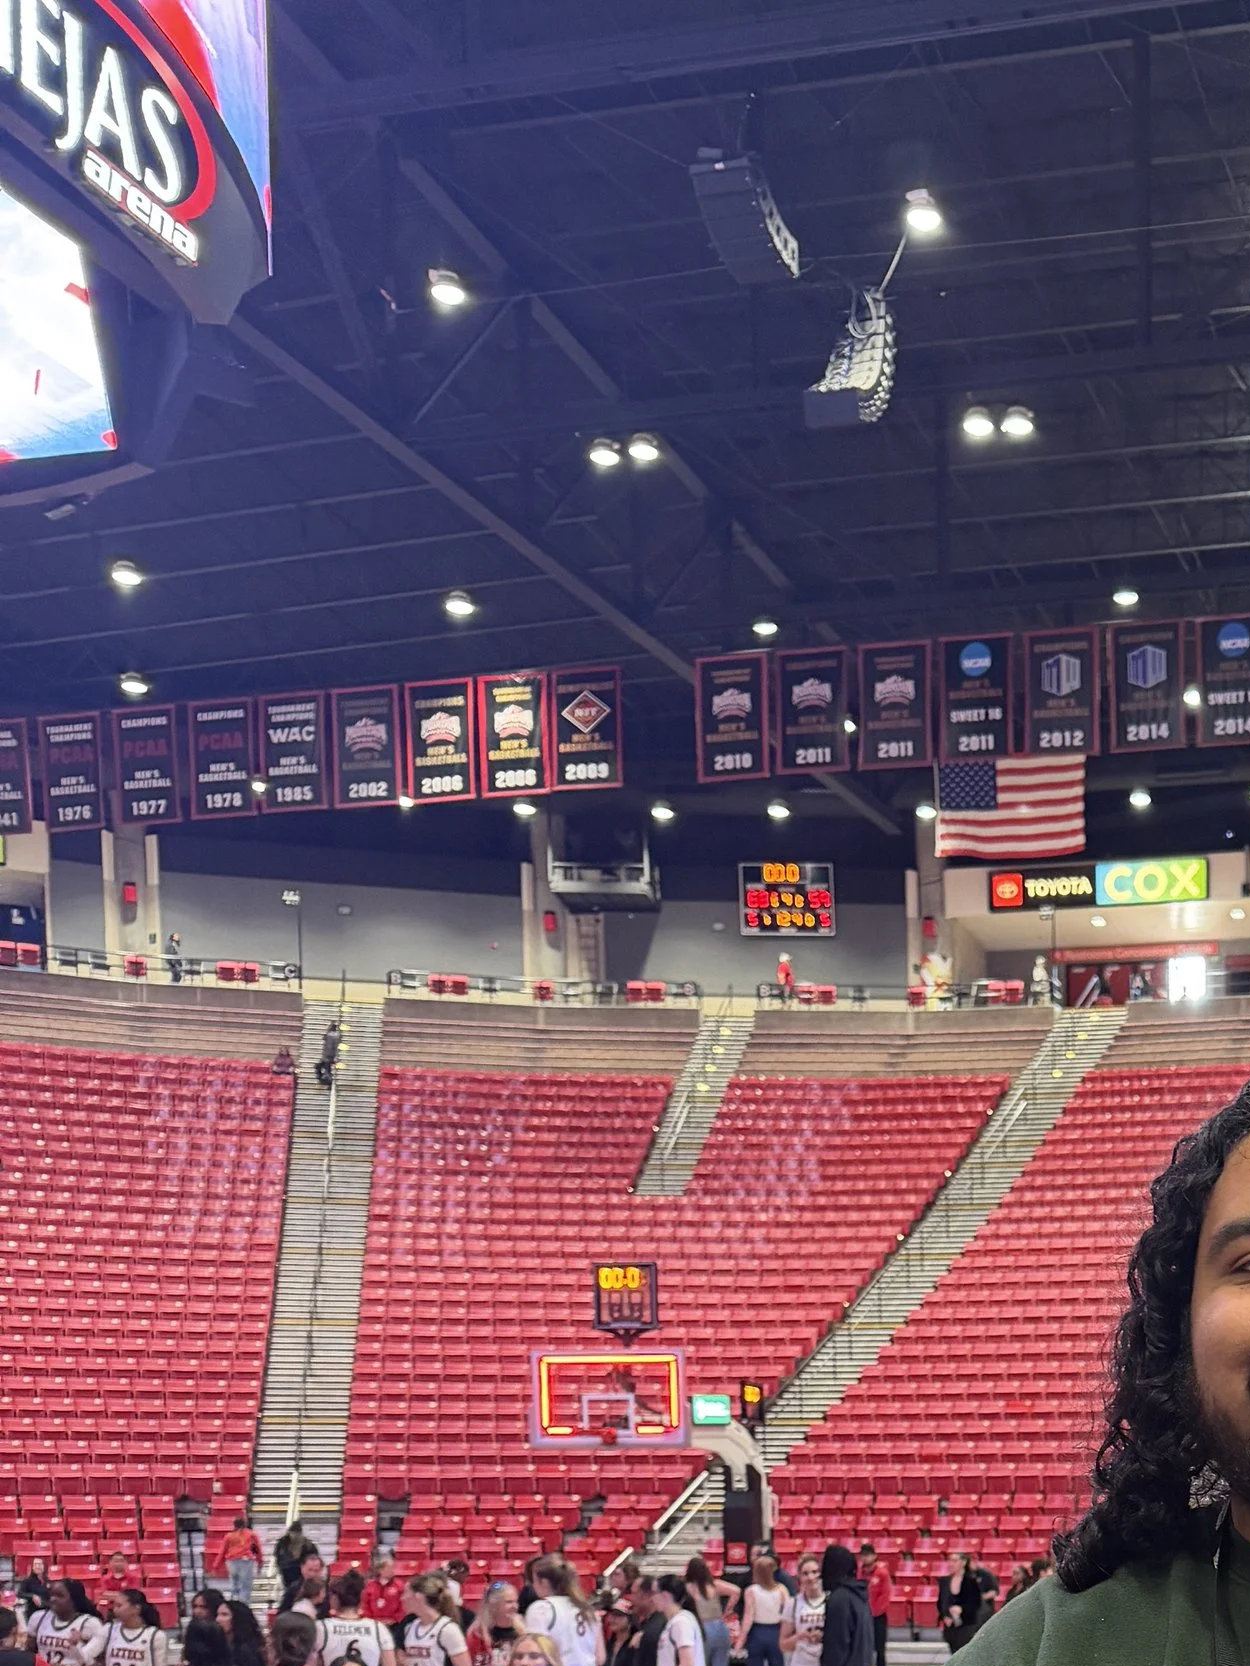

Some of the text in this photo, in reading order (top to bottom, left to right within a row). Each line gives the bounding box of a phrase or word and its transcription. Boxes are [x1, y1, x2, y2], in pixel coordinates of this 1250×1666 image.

[83, 148, 198, 262] arena
[1207, 690, 1245, 705] SWEET
[267, 725, 316, 743] WAC
[1039, 730, 1084, 748] 2012
[1126, 722, 1169, 742] 2014
[878, 740, 913, 758] 2011
[958, 734, 994, 752] 2011
[714, 752, 752, 771] 2010
[795, 747, 831, 765] 2011
[276, 785, 313, 803] 1985
[349, 781, 388, 798] 2002
[132, 799, 167, 816] 1977
[206, 792, 243, 809] 1978
[58, 805, 92, 822] 1976
[1024, 876, 1093, 898] TOYOTA
[1104, 862, 1201, 901] COX
[110, 1648, 145, 1661] AZTECS
